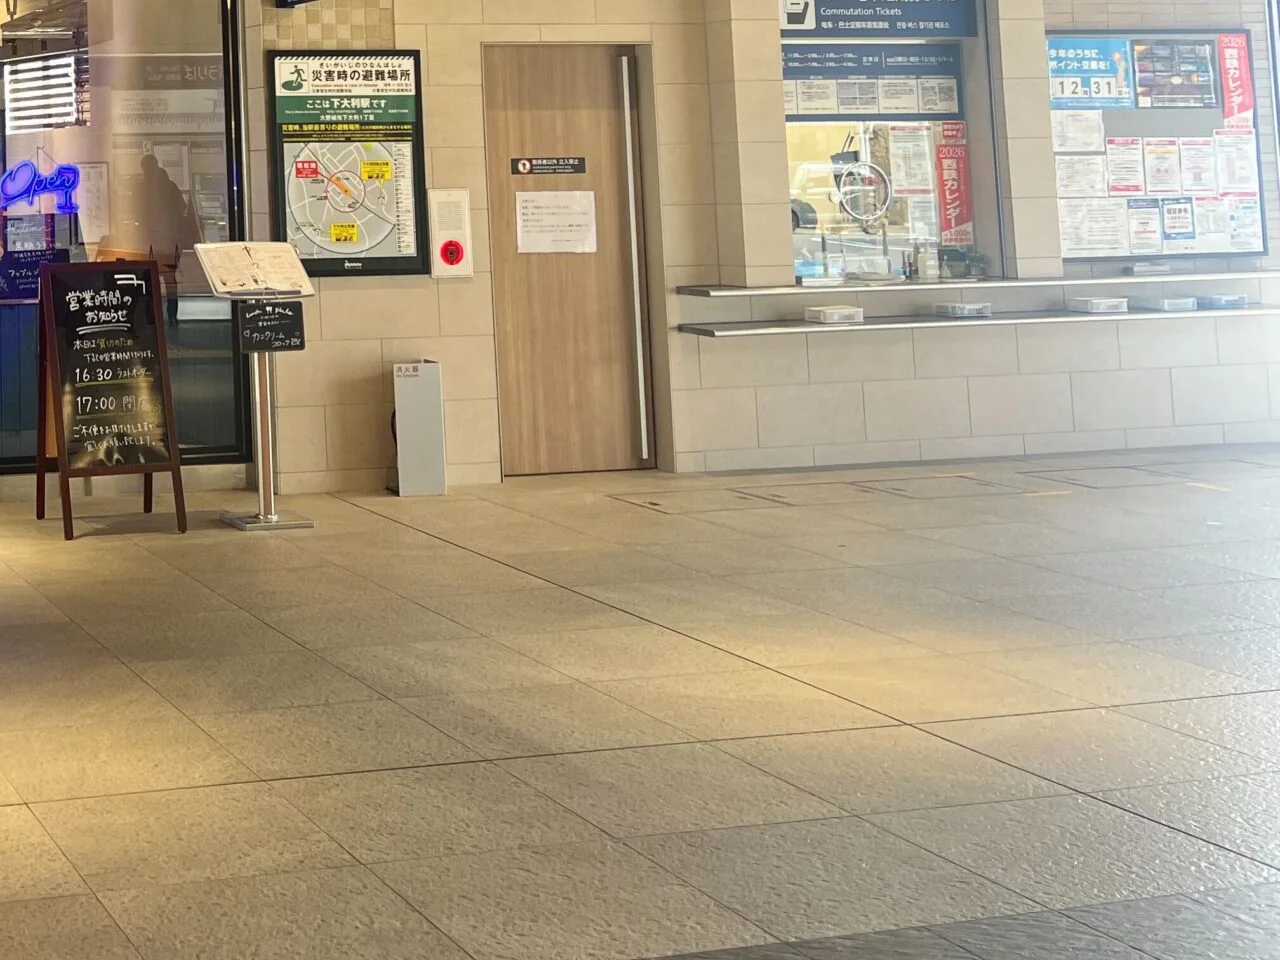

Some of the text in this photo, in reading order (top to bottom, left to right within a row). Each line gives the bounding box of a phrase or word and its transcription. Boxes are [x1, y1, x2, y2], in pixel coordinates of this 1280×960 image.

[821, 7, 902, 16] Commutation Tickets
[312, 69, 411, 82] 災害時の避難場所
[306, 97, 387, 109] ここは下大利駅です
[939, 146, 965, 158] 2026
[0, 161, 75, 207] Open
[66, 288, 132, 311] 営業時間の
[85, 309, 128, 323] お知らせ
[75, 367, 112, 383] 16:30
[76, 395, 116, 414] 17:00
